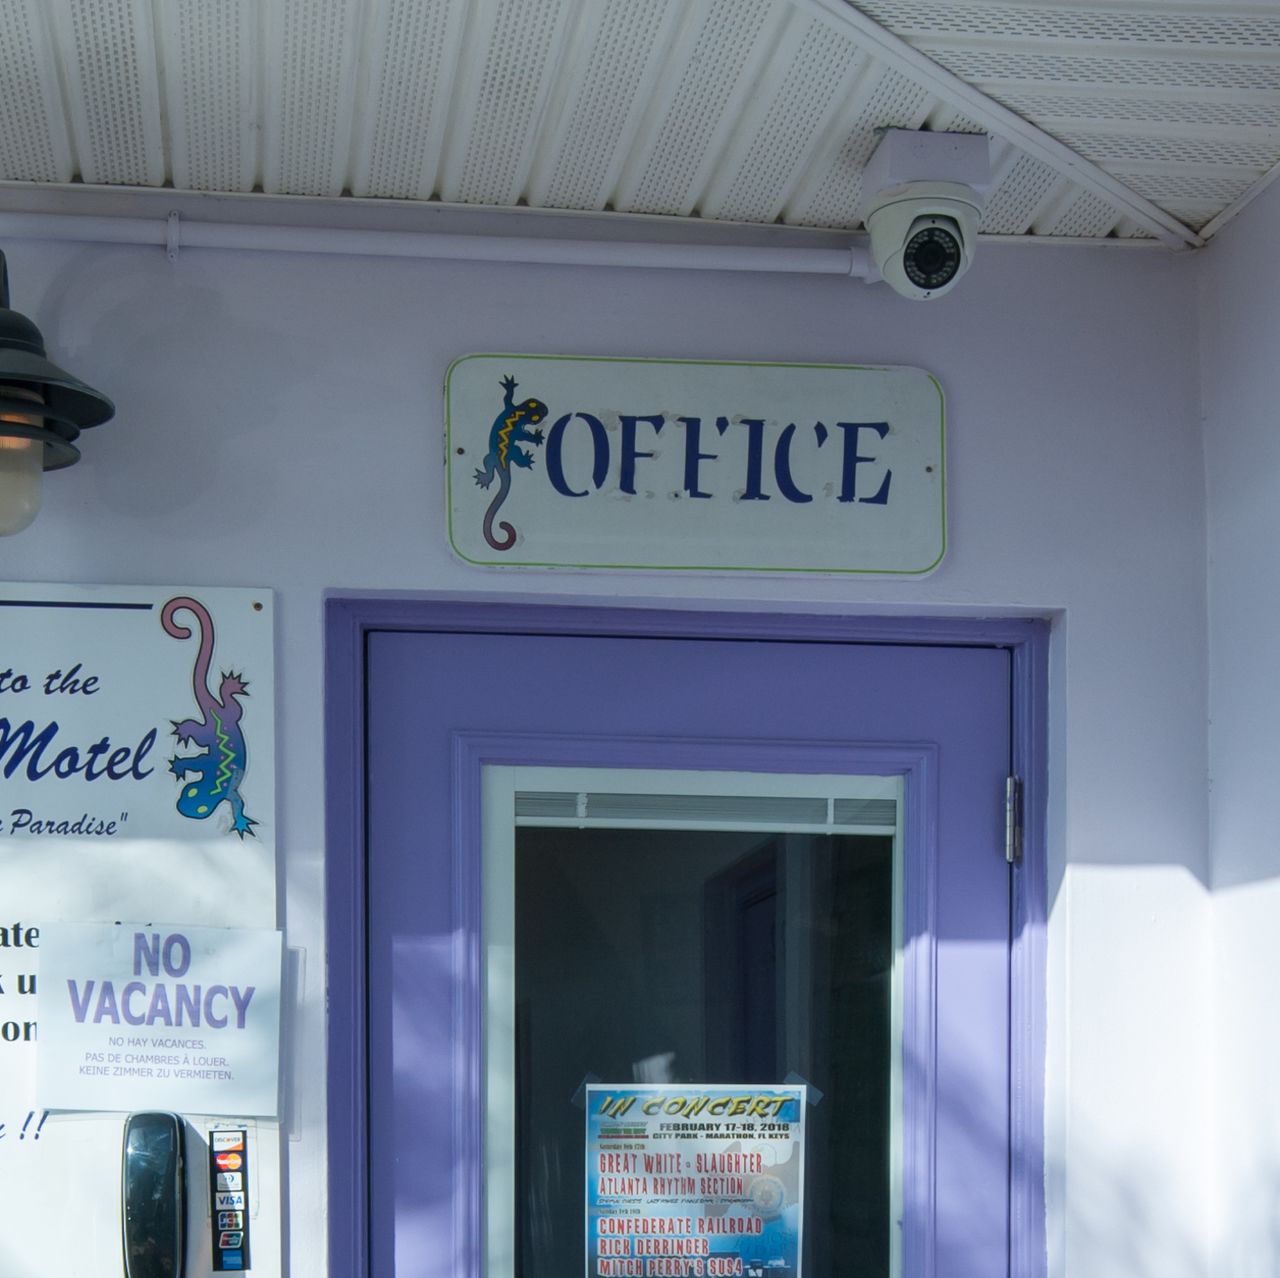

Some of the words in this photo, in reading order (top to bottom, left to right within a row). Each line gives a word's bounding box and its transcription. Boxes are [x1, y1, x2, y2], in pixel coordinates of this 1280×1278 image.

[545, 411, 892, 505] OFFICE
[42, 662, 101, 697] the
[8, 807, 128, 838] Paradise"
[132, 931, 192, 978] NO
[66, 979, 256, 1030] VACANCY
[108, 1036, 125, 1048] NO
[126, 1037, 149, 1049] HAY
[151, 1038, 207, 1050] VACANCES.
[85, 1052, 105, 1063] PAS
[107, 1053, 121, 1064] DE
[124, 1053, 180, 1065] CHAMBRES
[193, 1055, 230, 1067] LOUER.
[79, 1065, 110, 1077] KEINE
[112, 1066, 153, 1078] ZIMMER
[156, 1068, 170, 1078] ZU
[173, 1069, 235, 1081] VERMIETEN.
[598, 1095, 637, 1120] IN
[641, 1094, 795, 1119] CONCERT
[659, 1122, 721, 1131] FEBRUARY
[724, 1122, 757, 1132] 17-18,
[760, 1122, 790, 1131] 2018
[599, 1152, 637, 1174] GREAT
[643, 1152, 682, 1174] WHITE
[696, 1152, 762, 1174] SLAUGHTER
[599, 1177, 648, 1195] ATLANTA
[653, 1176, 696, 1195] RHYTHM
[700, 1176, 743, 1195] SECTION
[218, 1195, 243, 1205] VISA
[599, 1218, 691, 1234] CONFEDERATE
[697, 1217, 763, 1234] RAILROAD
[599, 1238, 630, 1255] RICK
[636, 1238, 709, 1256] DERRINGER
[599, 1259, 643, 1275] MITCH
[649, 1259, 704, 1276] PERRY'S
